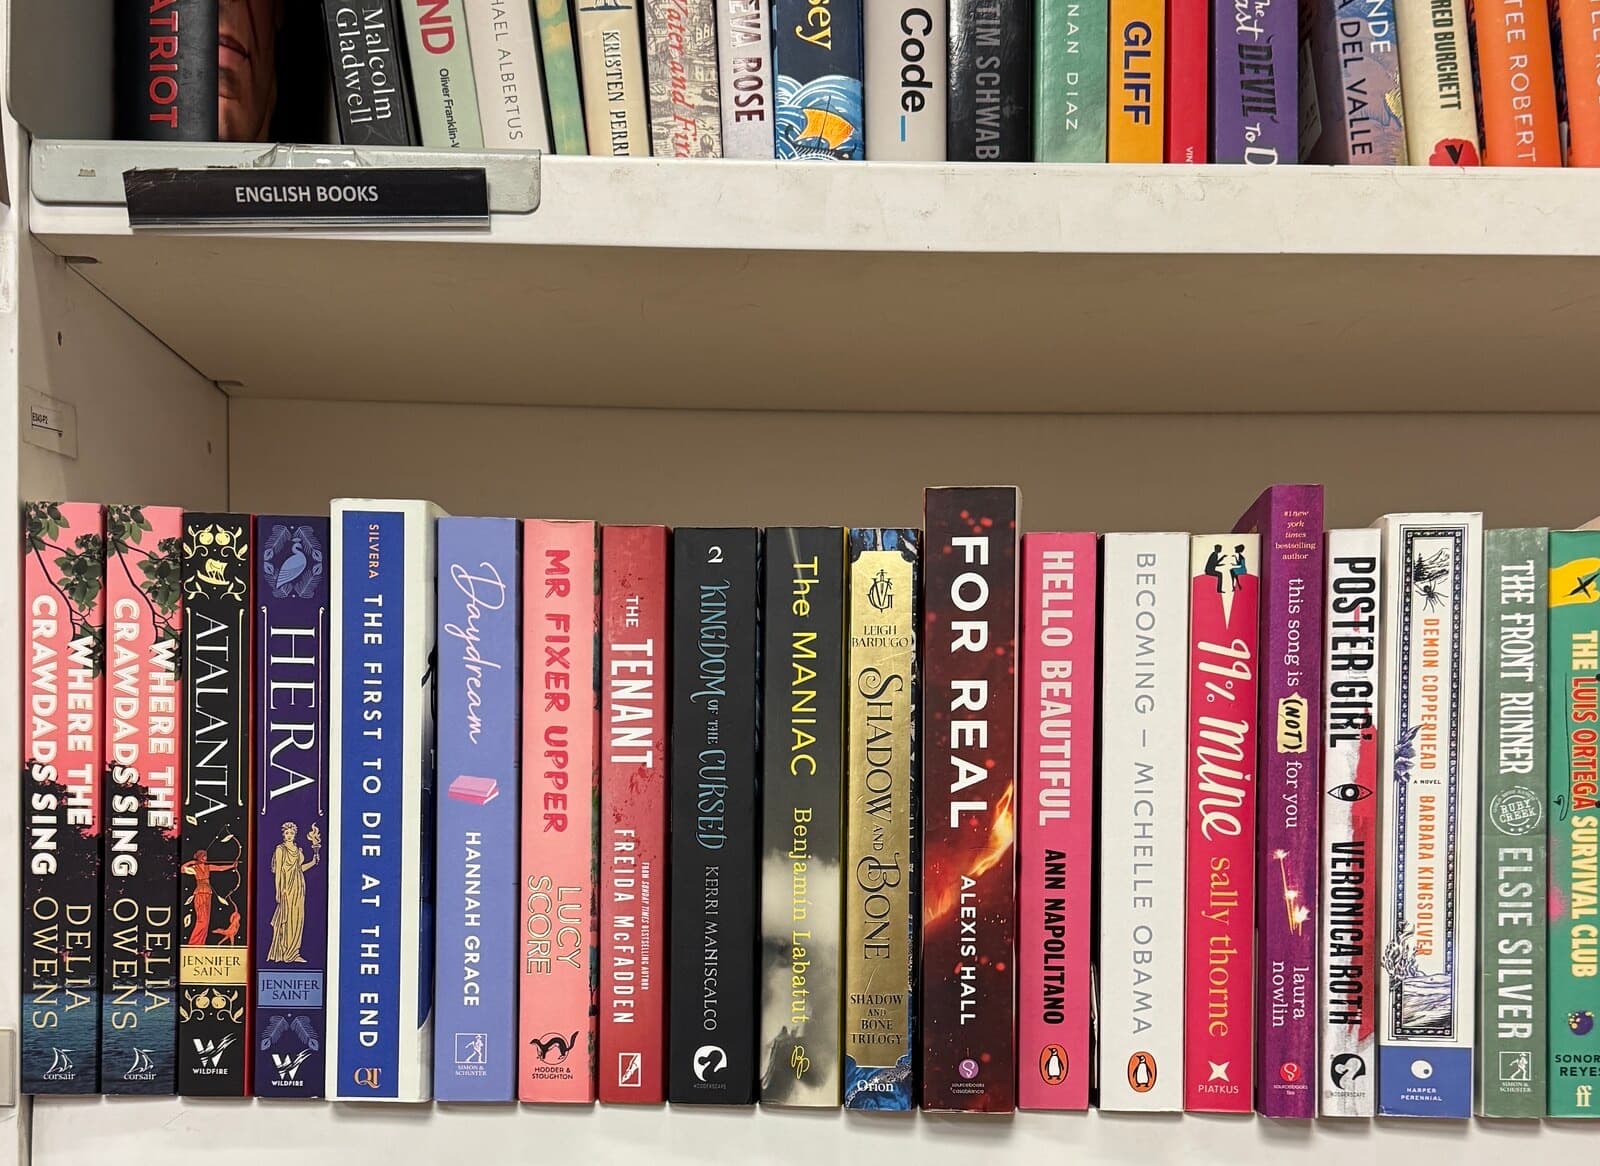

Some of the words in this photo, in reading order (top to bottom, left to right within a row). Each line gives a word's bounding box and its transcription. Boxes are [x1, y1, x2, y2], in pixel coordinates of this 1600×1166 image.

[975, 7, 1001, 47] TIM
[1066, 4, 1080, 54] NAN
[1340, 21, 1364, 68] DEL
[336, 7, 373, 124] Gladwell
[362, 7, 396, 120] Malcolm
[439, 68, 450, 101] Oliver
[497, 48, 524, 141] ALBERTUS
[601, 31, 624, 102] KRISTEN
[670, 57, 695, 109] and
[732, 57, 765, 122] ROSE
[1123, 21, 1151, 125] GLIFF
[1434, 31, 1461, 110] BURCHETT
[975, 56, 1001, 160] SCHWAB
[1065, 72, 1079, 130] DIAZ
[1244, 122, 1263, 143] To
[1345, 78, 1373, 156] VALLE
[1509, 55, 1536, 162] ROBERT
[234, 186, 311, 204] ENGLISH
[316, 185, 379, 203] BOOKS
[368, 524, 379, 579] SILVERA
[544, 550, 571, 598] MR
[707, 546, 724, 563] 2
[1275, 541, 1316, 550] bestselling
[1282, 552, 1309, 560] author
[626, 595, 639, 628] THE
[792, 556, 820, 617] The
[951, 536, 989, 652] FOR
[1040, 551, 1074, 647] HELLO
[1288, 578, 1303, 614] this
[1332, 556, 1376, 672] POSTER
[1501, 560, 1534, 605] THE
[363, 594, 383, 645] THE
[690, 579, 731, 703] KINGDOM
[852, 637, 909, 648] BARDUGO
[863, 625, 897, 636] LEIGH
[1134, 553, 1156, 714] BECOMING
[1284, 620, 1301, 666] song
[1423, 618, 1441, 669] DEMON
[1500, 613, 1535, 682] FRONT
[1572, 630, 1598, 670] THE
[444, 561, 506, 745] Daydream
[544, 613, 571, 712] FIXER
[1197, 638, 1252, 703] 99%
[1287, 671, 1303, 687] is
[31, 594, 58, 783] CRAWDADS
[67, 635, 94, 752] WHERE
[112, 598, 141, 785] CRAWDADS
[148, 638, 176, 755] WHERE
[195, 612, 229, 819] ATALANTA
[270, 626, 315, 800] HERA
[363, 662, 382, 740] FIRST
[610, 639, 654, 768] TENANT
[707, 699, 719, 715] OF
[790, 632, 817, 776] MANIAC
[1329, 680, 1374, 749] GIRL
[1571, 677, 1598, 723] LUIS
[707, 719, 719, 745] THE
[857, 667, 904, 823] SHADOW
[950, 680, 988, 828] REAL
[1039, 660, 1072, 826] BEAUTIFUL
[1282, 698, 1304, 751] (NOT)
[1420, 675, 1439, 770] COPPERHEAD
[1500, 692, 1534, 774] RUNNER
[67, 763, 93, 826] THE
[147, 766, 175, 828] THE
[362, 758, 382, 794] TO
[543, 725, 569, 832] UPPER
[695, 750, 729, 850] CURSED
[1197, 716, 1252, 841] mine
[1286, 761, 1303, 783] for
[1571, 728, 1598, 811] ORTEGA
[31, 793, 58, 876] SING
[111, 795, 139, 877] SING
[361, 812, 381, 857] DIE
[872, 824, 884, 850] AND
[1133, 762, 1154, 908] MICHELLE
[1282, 788, 1298, 828] you
[1418, 796, 1436, 861] BARBARA
[1499, 799, 1532, 815] RUBY
[1499, 807, 1537, 824] CREEK
[361, 874, 381, 907] AT
[464, 831, 482, 927] HANNAH
[613, 829, 635, 902] FREIDA
[705, 866, 720, 915] KERRI
[1045, 849, 1066, 889] ANN
[1202, 857, 1239, 925] sally
[1498, 848, 1533, 926] ELSIE
[1570, 815, 1598, 919] SURVIVAL
[526, 875, 552, 976] SCORE
[556, 886, 582, 969] LUCY
[856, 852, 901, 960] BONE
[960, 875, 977, 957] ALEXIS
[1331, 840, 1365, 958] VERONICA
[1417, 866, 1434, 957] KINGSOLVER
[32, 896, 59, 1029] OWENS
[65, 903, 92, 1012] DELIA
[112, 898, 139, 1030] OWENS
[144, 905, 172, 1013] DELIA
[183, 955, 241, 969] JENNIFER
[193, 966, 231, 977] SAINT
[360, 925, 380, 976] THE
[463, 936, 481, 1006] GRACE
[703, 921, 720, 1031] MANISCALCO
[791, 930, 811, 1024] Labatut
[1043, 898, 1066, 1025] NAPOLITANO
[1132, 925, 1153, 1034] OBAMA
[1571, 924, 1598, 978] CLUB
[261, 978, 321, 992] JENNIFER
[272, 990, 310, 1001] SAINT
[850, 993, 903, 1005] SHADOW
[867, 1008, 887, 1017] AND
[960, 966, 977, 1025] HALL
[1208, 934, 1238, 1038] thorne
[1272, 960, 1289, 1028] nowlin
[1292, 966, 1309, 1020] laura
[1328, 967, 1363, 1025] ROTH
[1498, 939, 1533, 1039] SILVER
[359, 992, 379, 1047] END
[851, 1033, 903, 1045] TRILOGY
[861, 1019, 893, 1030] BONE
[43, 1071, 76, 1081] corsair
[124, 1072, 157, 1081] corsair
[192, 1067, 229, 1075] WILDFIRE
[271, 1079, 304, 1087] WILDFIRE
[531, 1072, 574, 1080] STOUGHTON
[857, 1080, 895, 1092] Orion
[1198, 1084, 1240, 1094] PIATKUS
